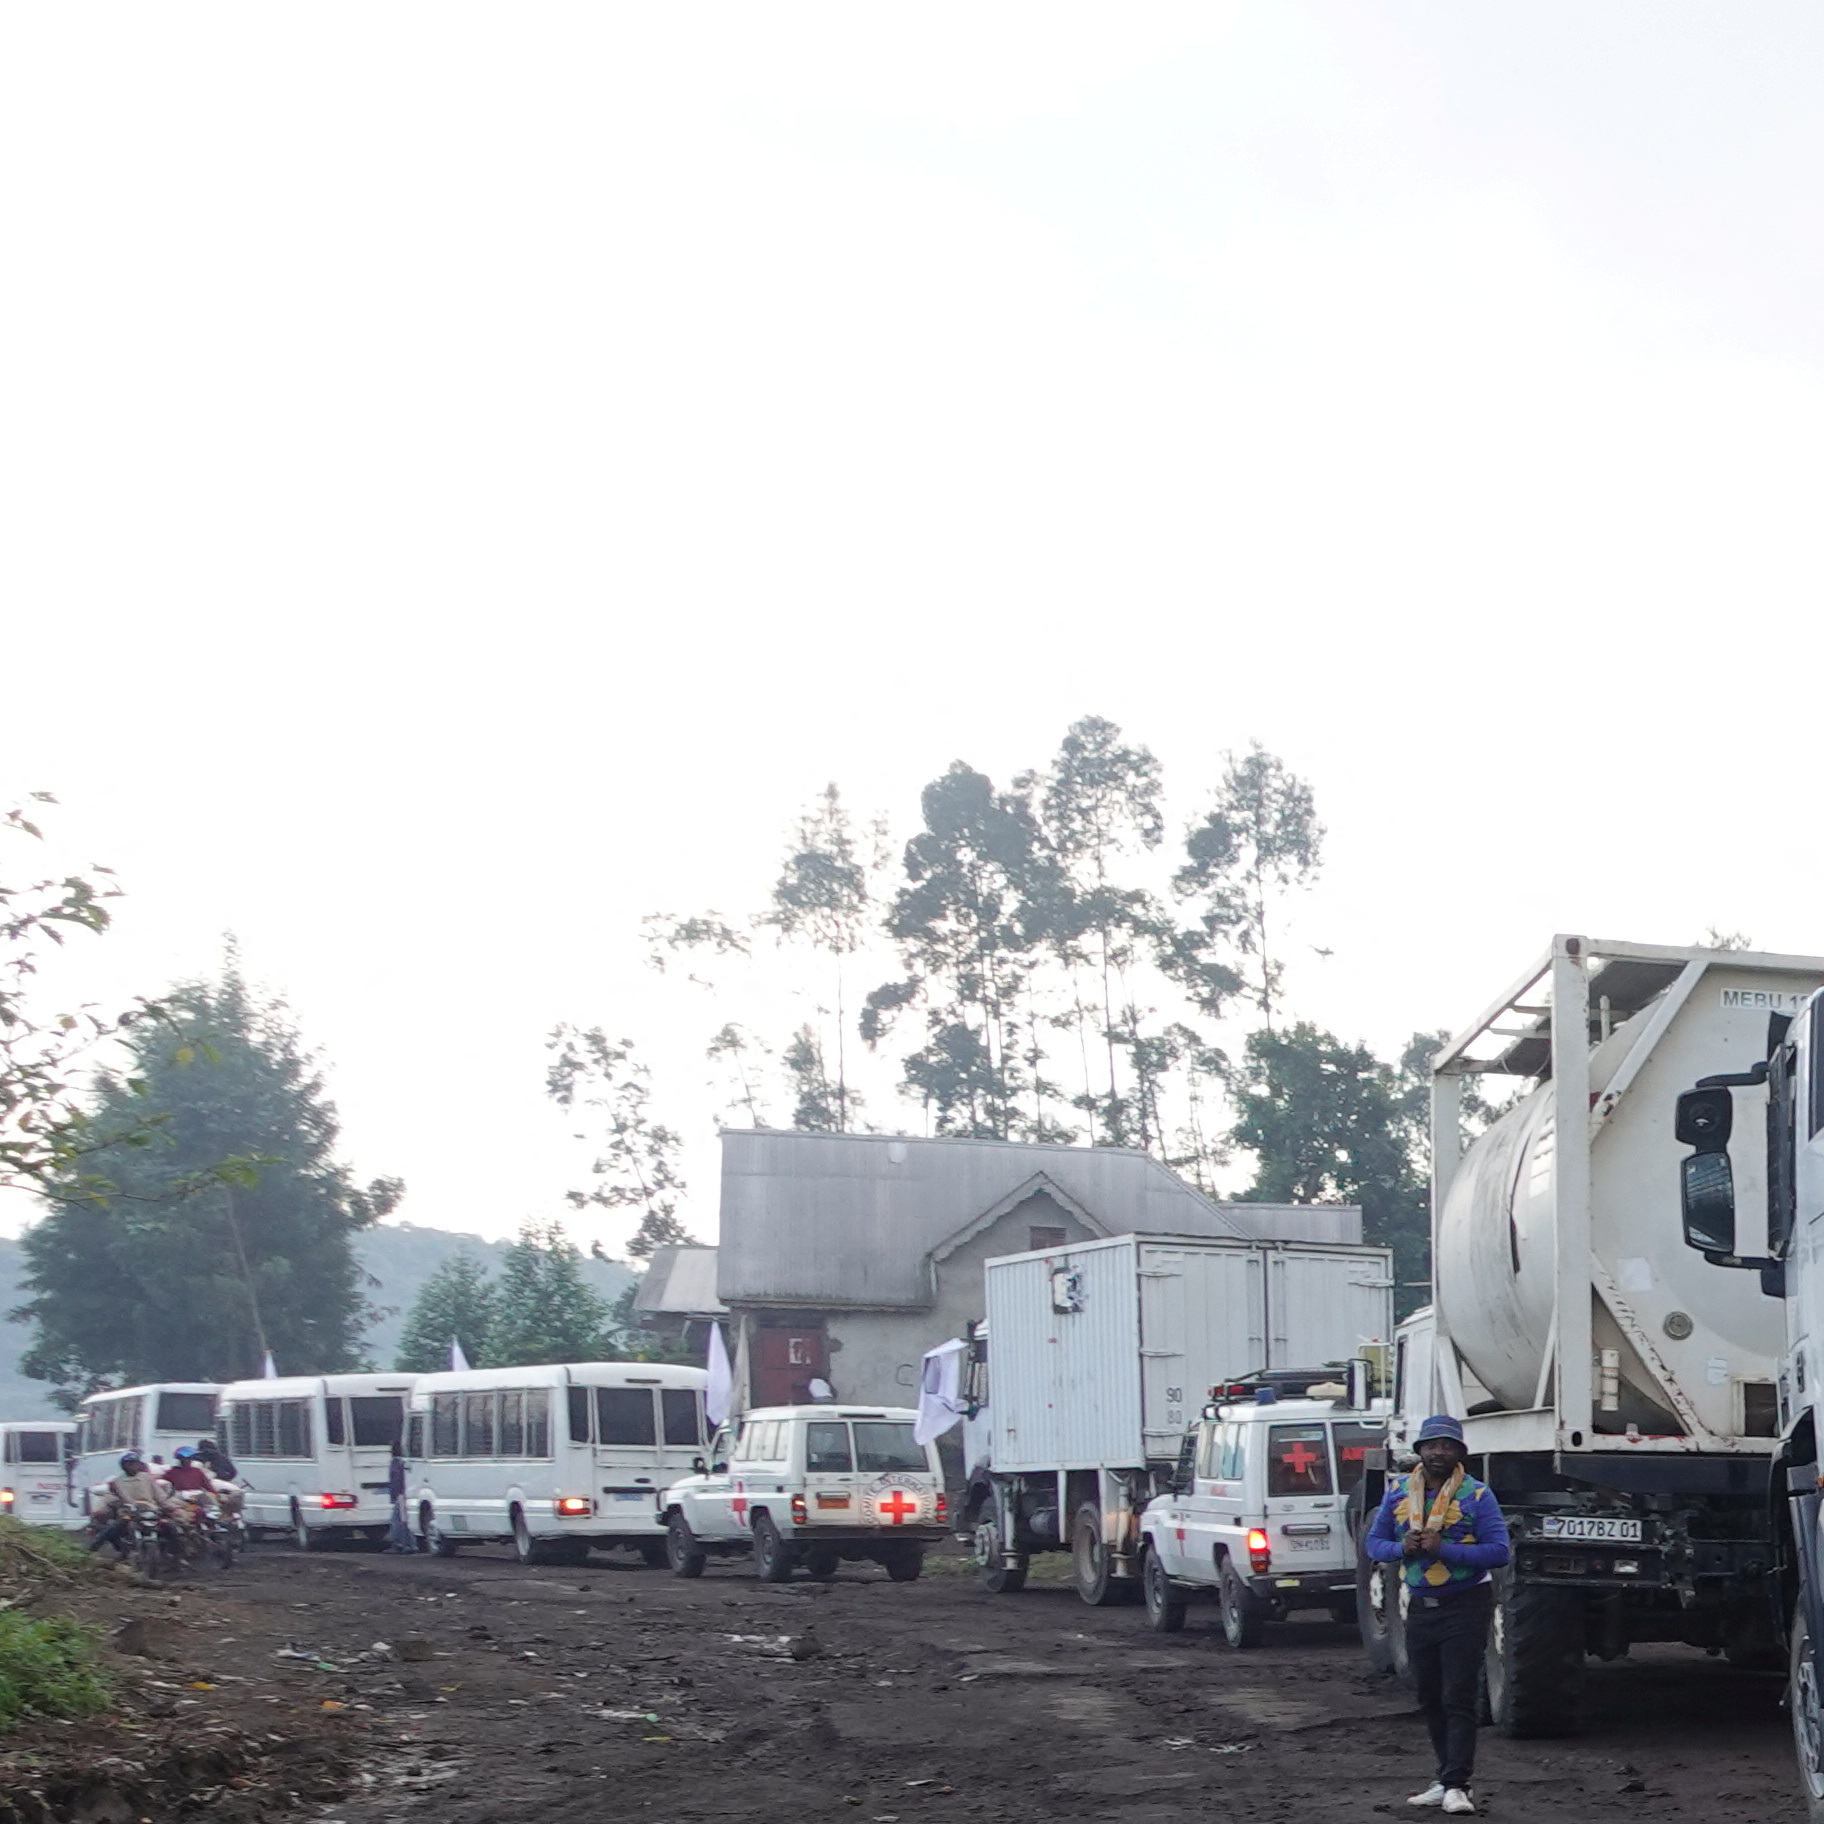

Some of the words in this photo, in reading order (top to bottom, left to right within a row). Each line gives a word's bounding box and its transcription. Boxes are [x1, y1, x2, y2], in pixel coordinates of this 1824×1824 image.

[1723, 990, 1782, 1009] MEBU
[1557, 1520, 1615, 1537] 7017BZ
[1620, 1521, 1639, 1538] 01
